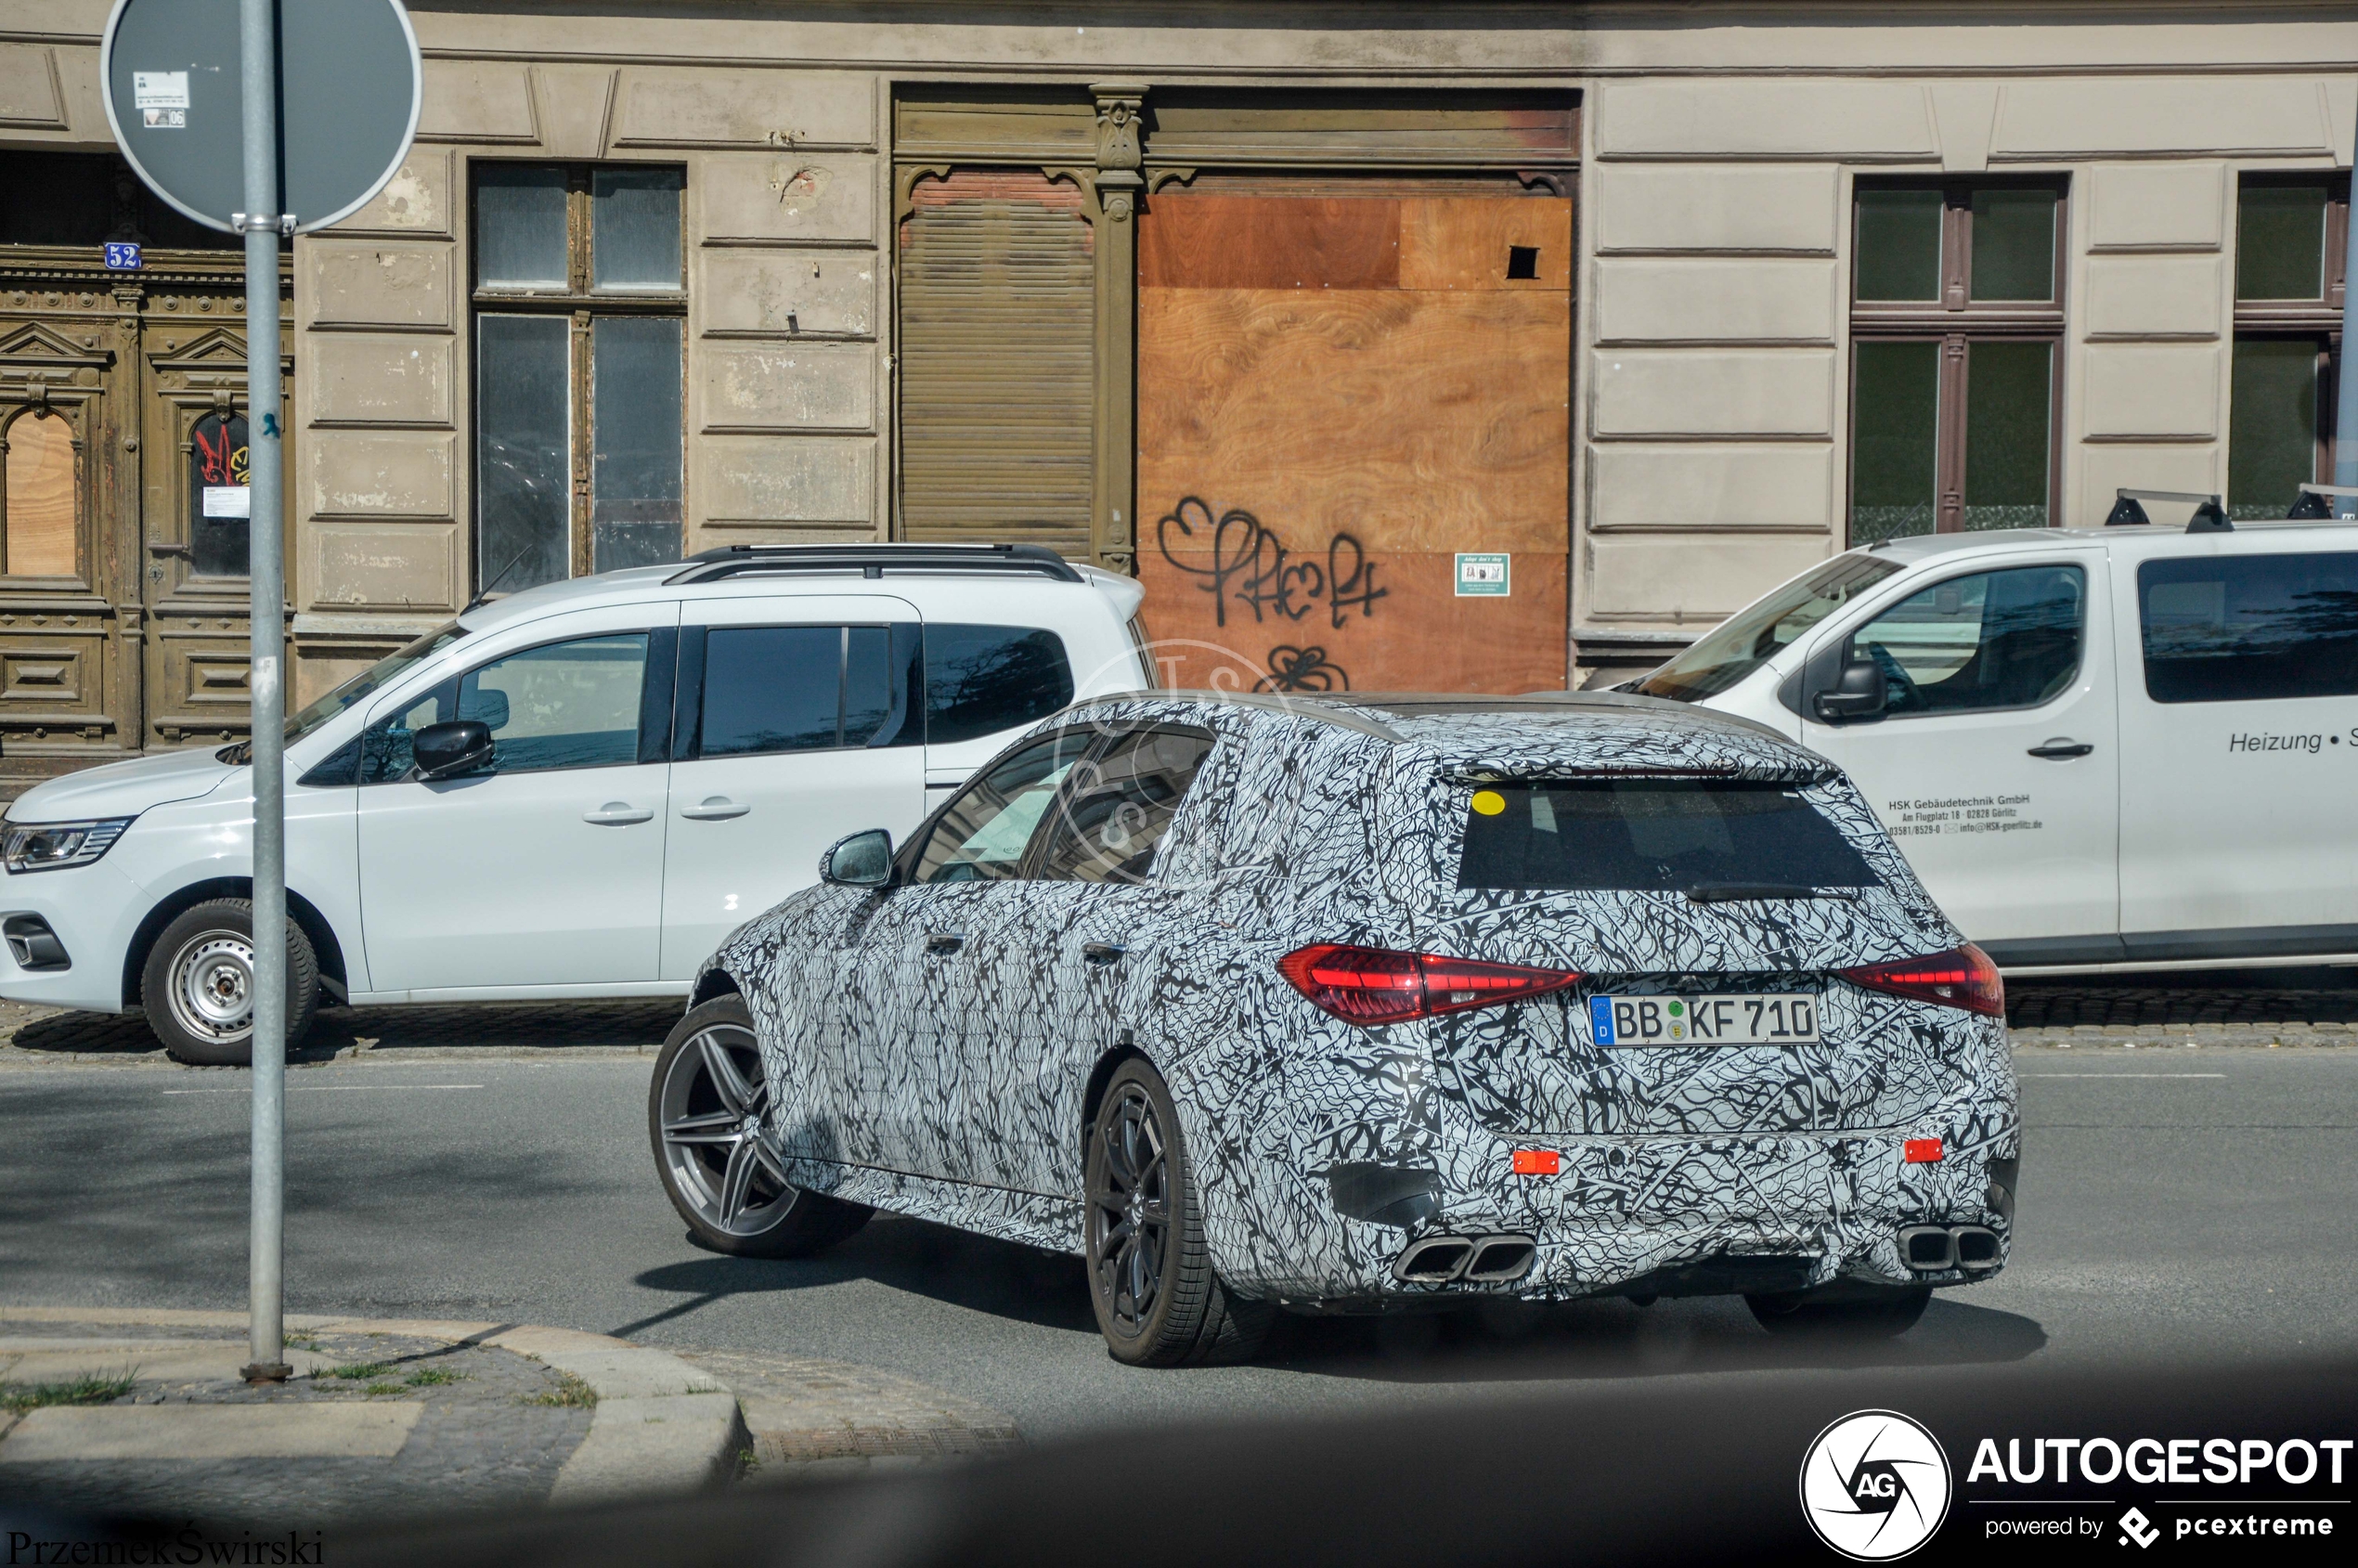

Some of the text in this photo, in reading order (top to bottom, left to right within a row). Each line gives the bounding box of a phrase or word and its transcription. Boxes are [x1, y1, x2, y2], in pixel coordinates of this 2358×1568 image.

[110, 246, 137, 266] 52
[2230, 732, 2323, 754] Heizung
[1888, 794, 2030, 811] HSK Gebäudetechnik GmbH
[1902, 807, 2017, 823] Am Flugplatz 18 02828 Görlitz
[1613, 1000, 1813, 1039] BB KF 710
[1600, 1026, 1608, 1038] D
